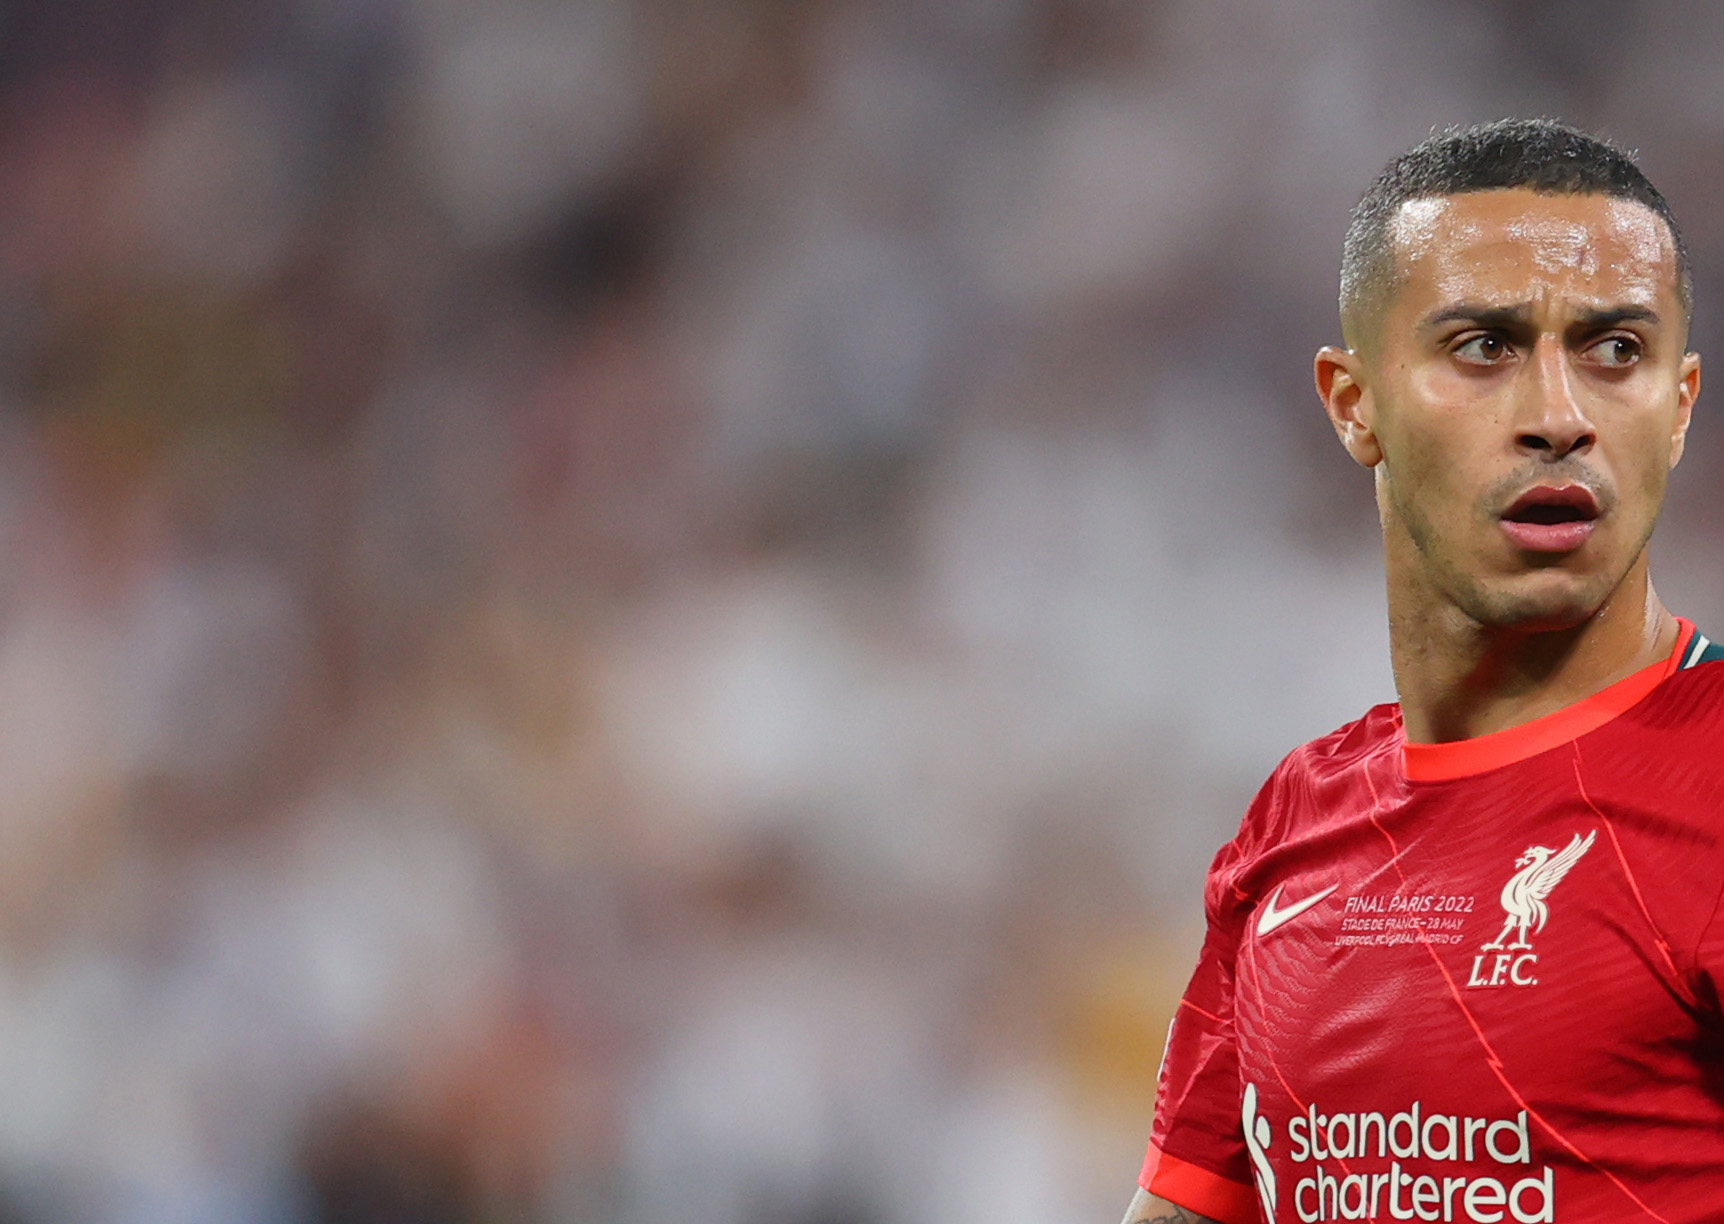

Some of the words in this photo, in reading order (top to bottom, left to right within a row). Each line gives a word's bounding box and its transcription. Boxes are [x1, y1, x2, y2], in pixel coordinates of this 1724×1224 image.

[1341, 918, 1371, 931] STADE
[1370, 918, 1385, 930] DE
[1439, 918, 1465, 931] MAY
[1344, 896, 1385, 913] FINAL
[1388, 895, 1435, 913] PARIS
[1434, 896, 1475, 913] 2022
[1288, 1100, 1531, 1164] standard
[1294, 1160, 1555, 1224] chartered
